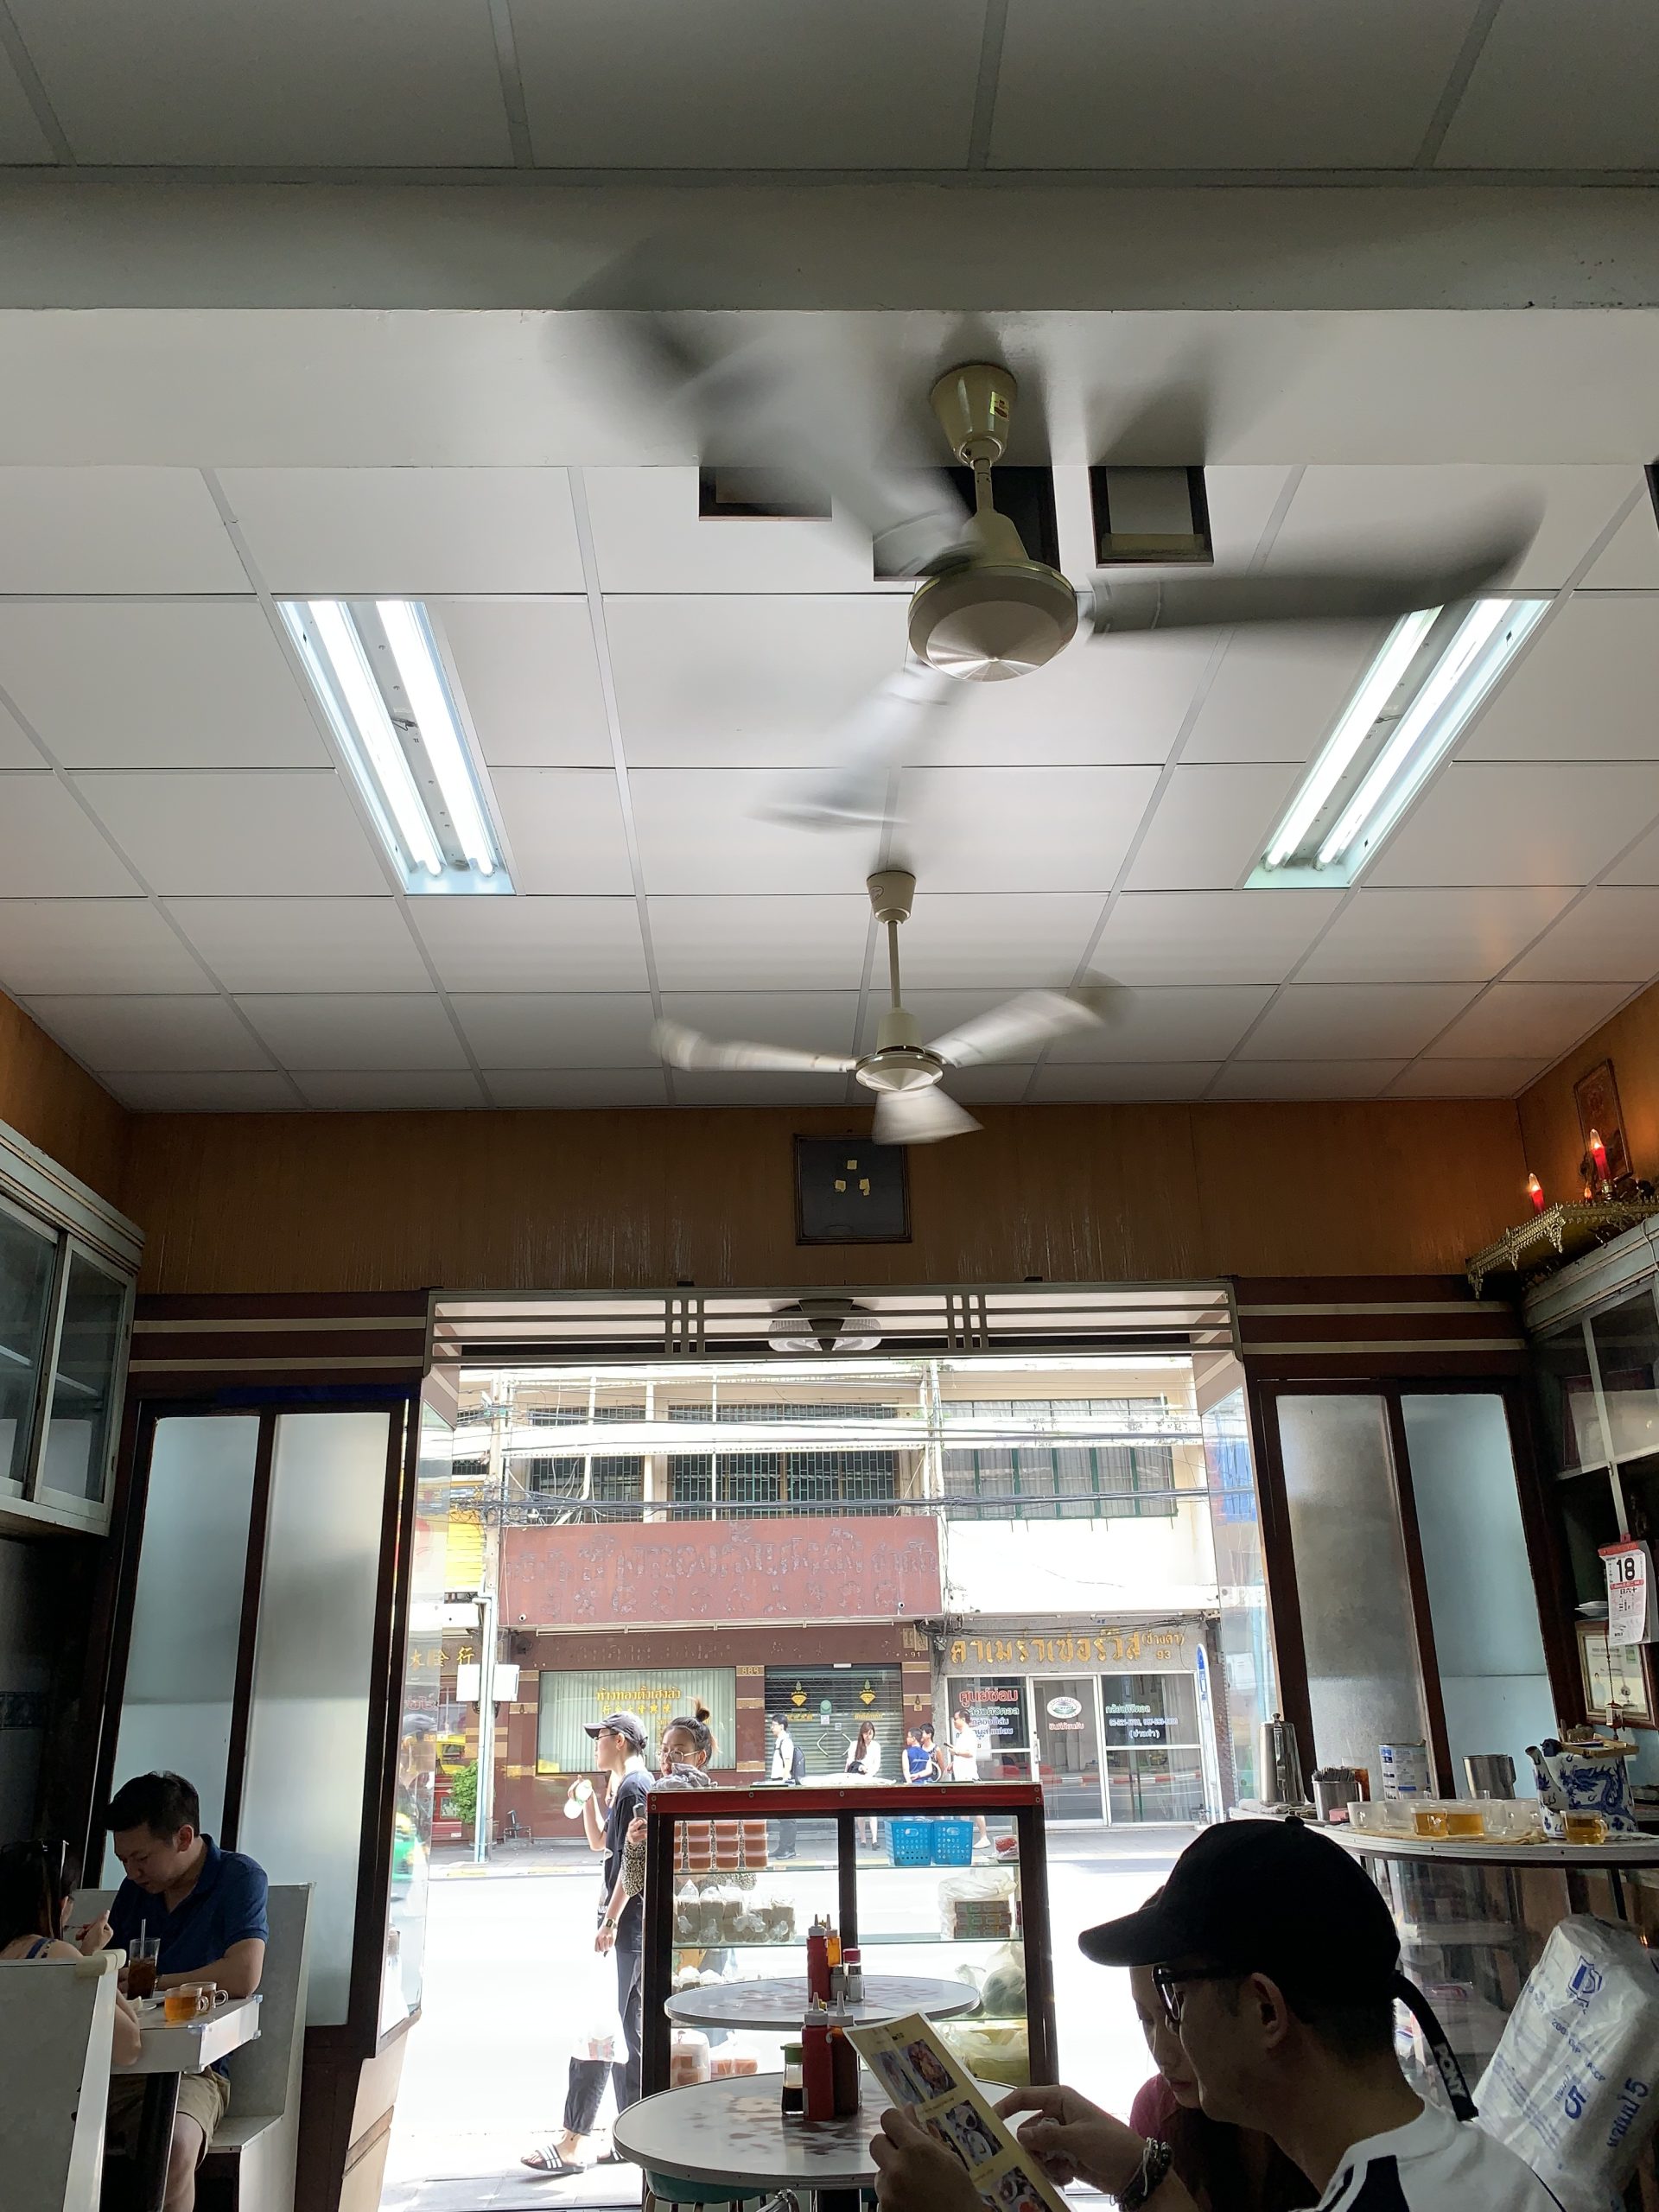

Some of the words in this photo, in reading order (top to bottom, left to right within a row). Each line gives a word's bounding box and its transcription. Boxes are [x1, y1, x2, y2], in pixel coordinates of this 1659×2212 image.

[1617, 1557, 1635, 1581] 18
[1156, 1650, 1172, 1660] 93
[1624, 2077, 1649, 2098] 5
